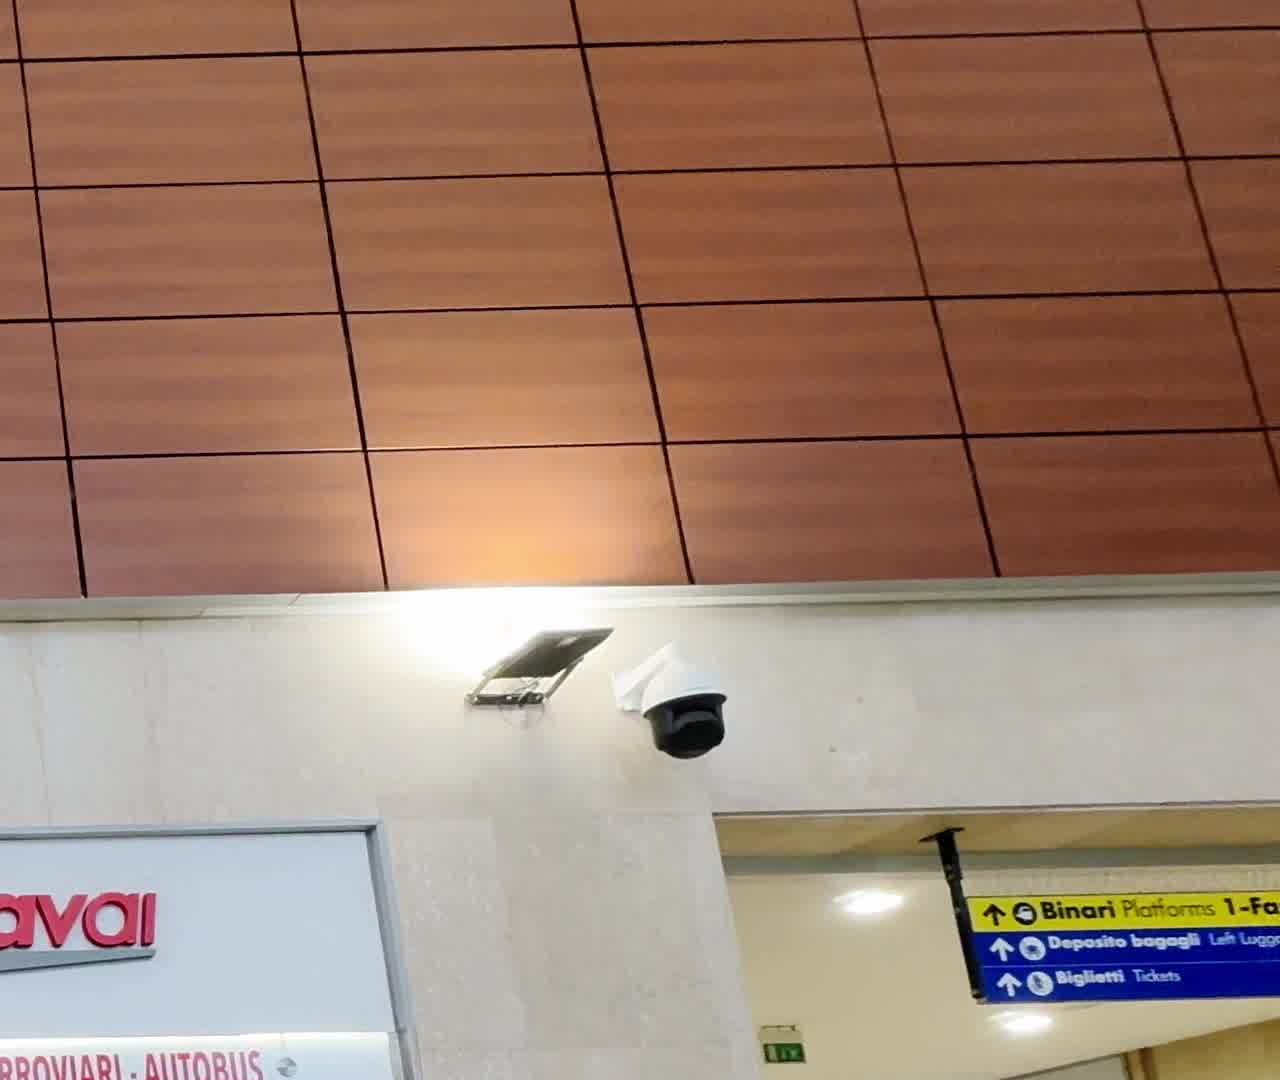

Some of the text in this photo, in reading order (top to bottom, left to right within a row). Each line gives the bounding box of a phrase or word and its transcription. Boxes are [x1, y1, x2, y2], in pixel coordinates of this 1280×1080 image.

[1040, 898, 1216, 920] Binari Platforms
[1047, 934, 1127, 952] Deposito
[1130, 932, 1200, 950] bagagli
[1055, 969, 1182, 986] Biglietti Tickets
